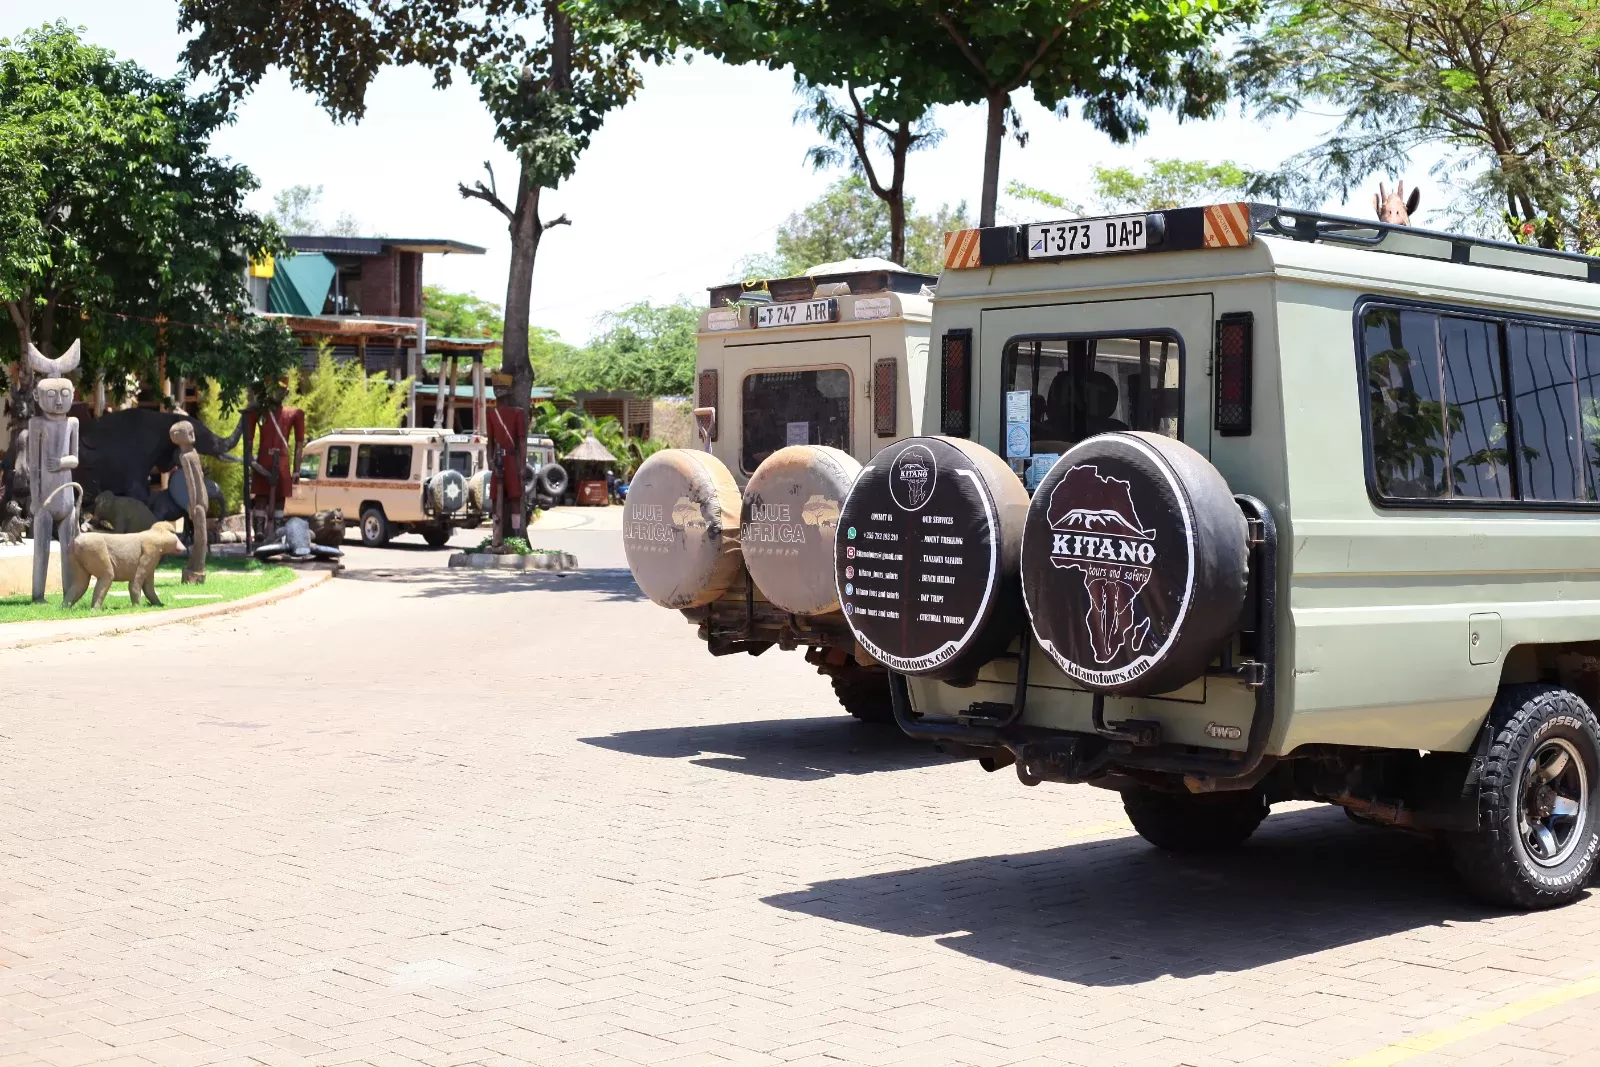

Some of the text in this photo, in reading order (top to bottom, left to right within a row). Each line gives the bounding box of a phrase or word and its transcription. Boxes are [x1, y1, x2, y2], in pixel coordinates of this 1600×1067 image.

[1040, 220, 1142, 252] T 373 DAP
[766, 302, 826, 324] T 747 ATR
[624, 521, 674, 542] AFRICA
[933, 516, 954, 525] SERVICES
[741, 522, 806, 544] AFRICA
[944, 556, 963, 564] SAFARIS
[1052, 534, 1156, 564] KITANO
[1088, 564, 1148, 582] tours and safaris
[930, 594, 944, 603] TRIPS
[942, 615, 964, 625] TOURISM
[859, 634, 958, 669] www.kitanotours.com
[1049, 644, 1150, 684] www.kitanotours.com
[1533, 716, 1582, 743] KAPSEN
